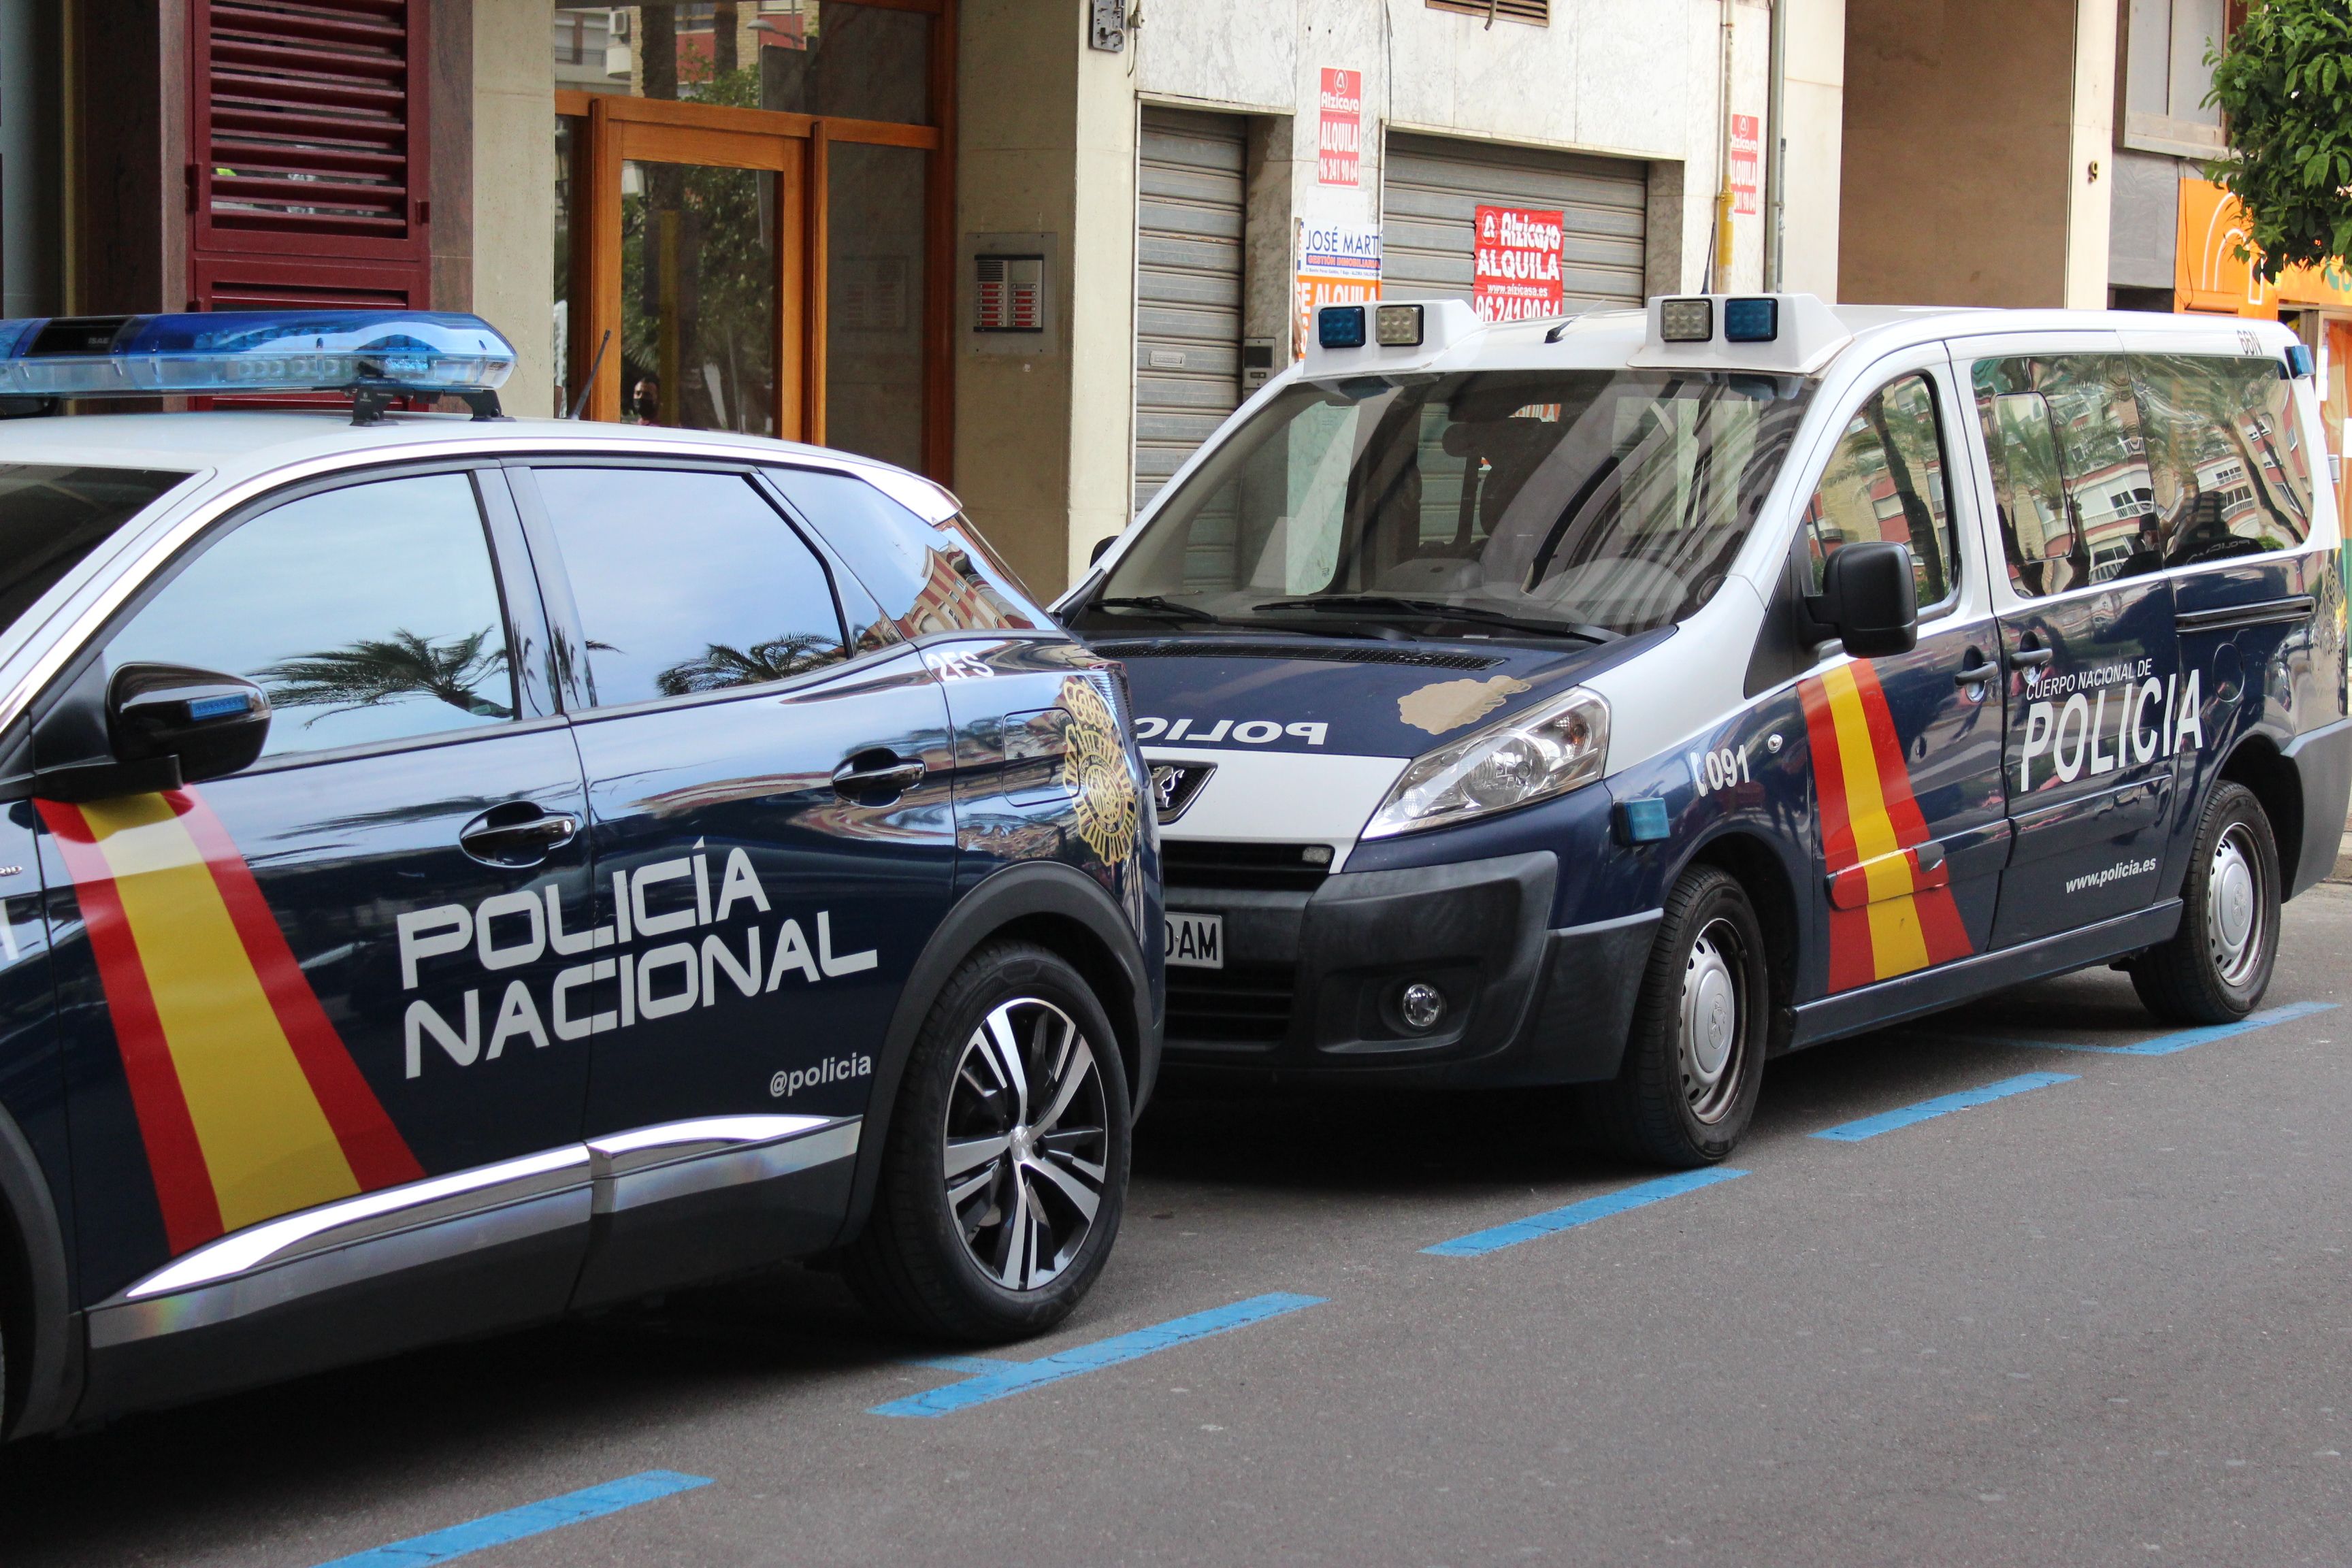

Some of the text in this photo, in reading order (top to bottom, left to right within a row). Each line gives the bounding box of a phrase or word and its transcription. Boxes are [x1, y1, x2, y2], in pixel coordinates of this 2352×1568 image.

[1321, 91, 1360, 112] Alzicasa
[1320, 121, 1359, 154] ALQUILA
[1320, 157, 1358, 182] 96 241 90 64
[1731, 159, 1756, 187] LQUILA
[2089, 161, 2098, 183] 9
[1306, 226, 1338, 252] JOSÉ
[1343, 229, 1383, 256] MARTÍ
[1477, 248, 1561, 280] ALQUILA
[2236, 329, 2264, 356] 66N
[926, 651, 994, 681] 2FS
[2026, 658, 2153, 701] CUERPO NACIONAL DE
[2021, 669, 2203, 792] POLICIA
[1705, 744, 1750, 791] 091
[2065, 858, 2157, 894] www.policia.es
[396, 835, 771, 990] POLICÍA
[405, 911, 878, 1079] NACIONAL
[770, 1052, 872, 1098] @policia
